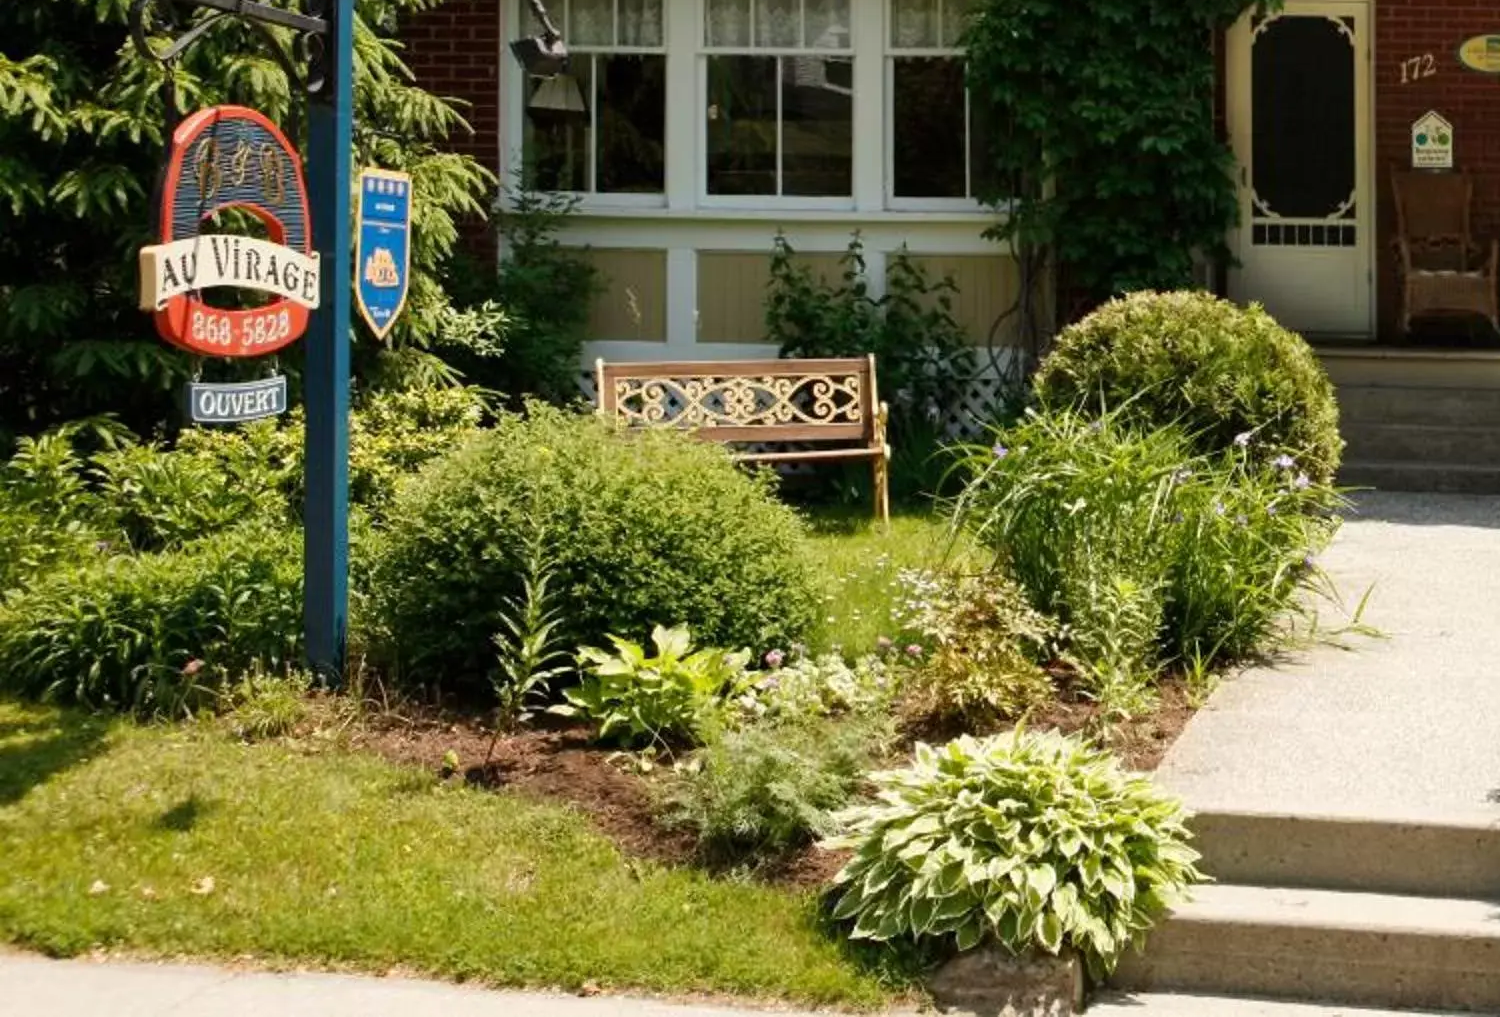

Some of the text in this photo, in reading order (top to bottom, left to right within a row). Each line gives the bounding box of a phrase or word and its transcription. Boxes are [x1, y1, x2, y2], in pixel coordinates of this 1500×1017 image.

[1401, 53, 1437, 84] 172
[161, 252, 198, 292] AU
[200, 387, 279, 416] OUVERT
